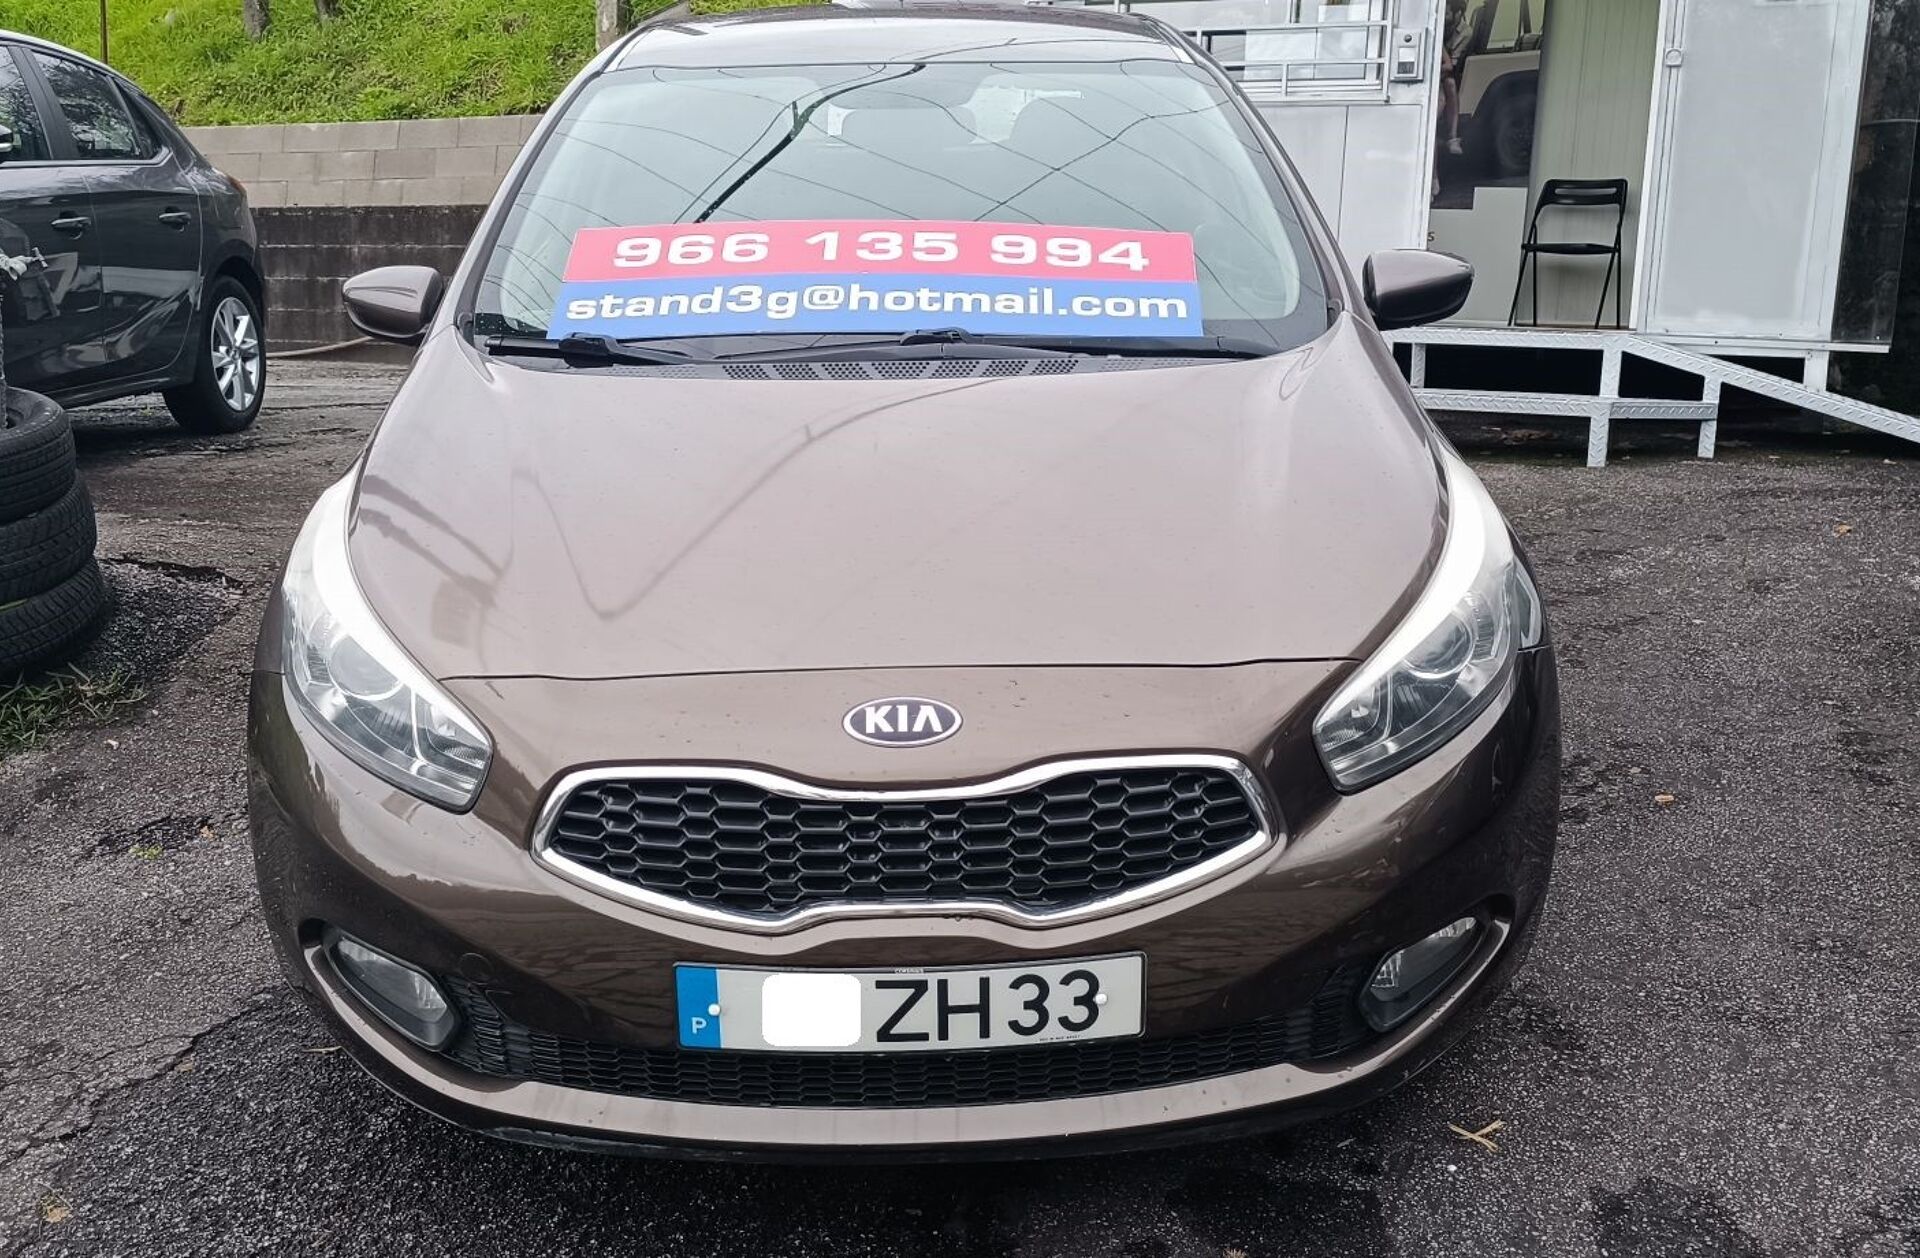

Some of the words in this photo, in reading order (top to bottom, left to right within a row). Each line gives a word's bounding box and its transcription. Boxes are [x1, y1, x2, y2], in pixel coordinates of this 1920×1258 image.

[613, 233, 771, 268] 966
[805, 231, 959, 262] 135
[991, 234, 1150, 272] 994
[566, 283, 1188, 320] stand3g@hotmail.com
[864, 704, 943, 734] KIA
[692, 1016, 707, 1034] P
